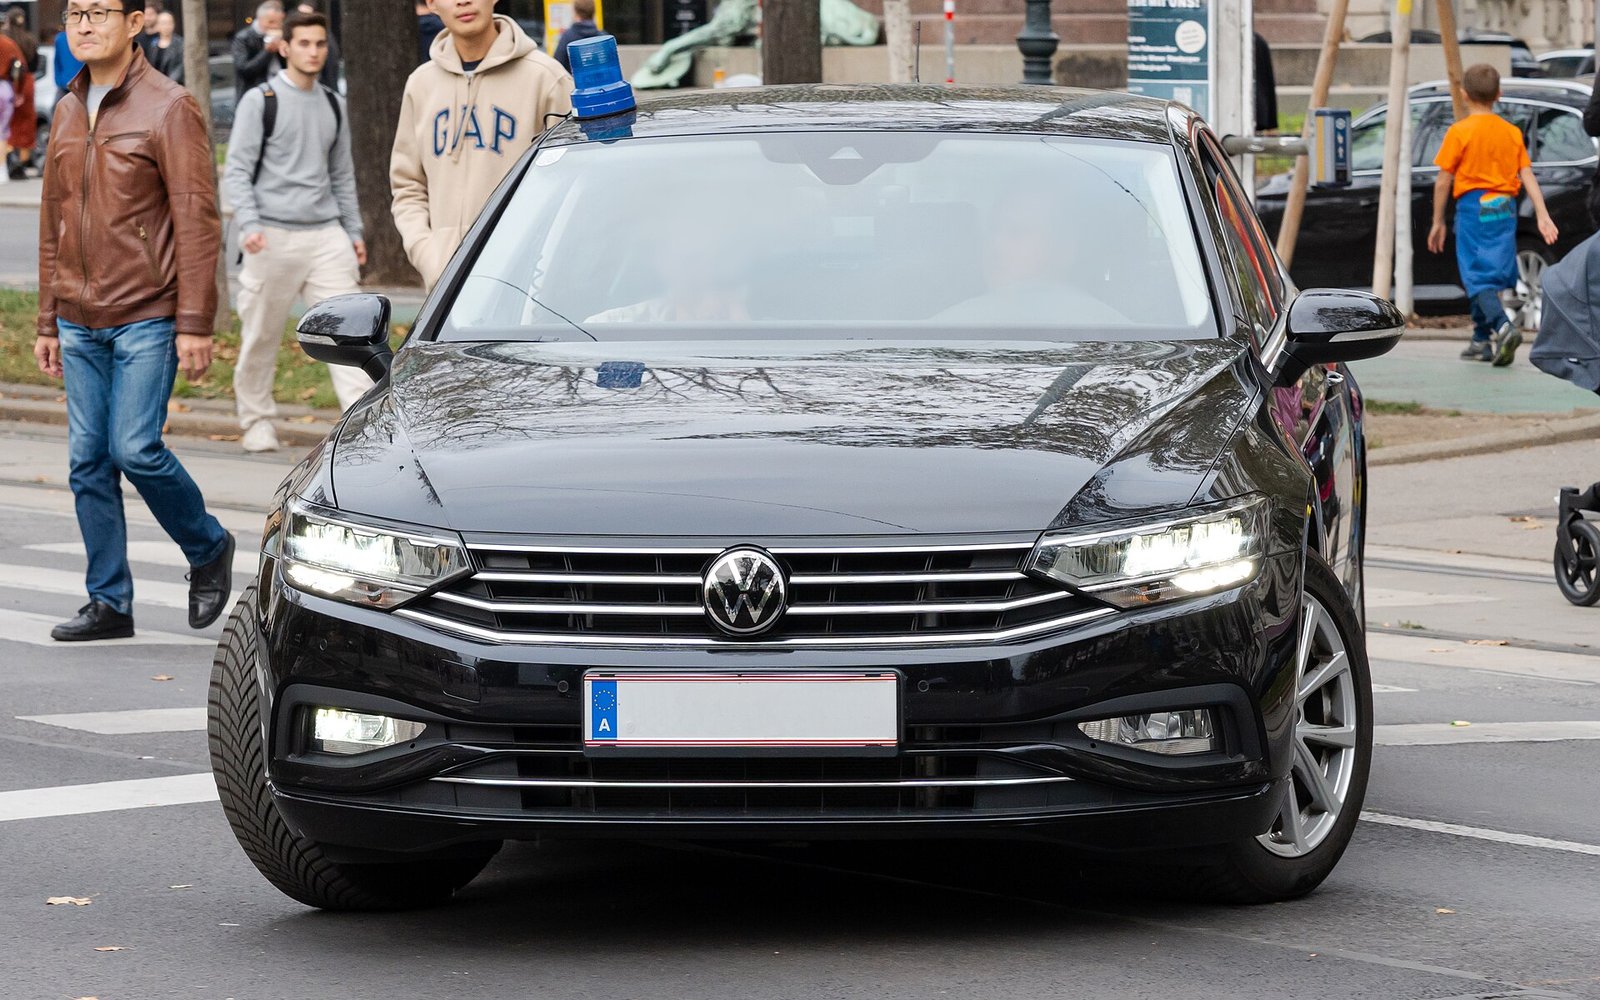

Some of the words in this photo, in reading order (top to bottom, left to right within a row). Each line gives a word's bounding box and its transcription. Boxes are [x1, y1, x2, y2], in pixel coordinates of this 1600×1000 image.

[433, 104, 517, 156] GAP
[708, 552, 782, 626] VW
[598, 717, 611, 732] A
